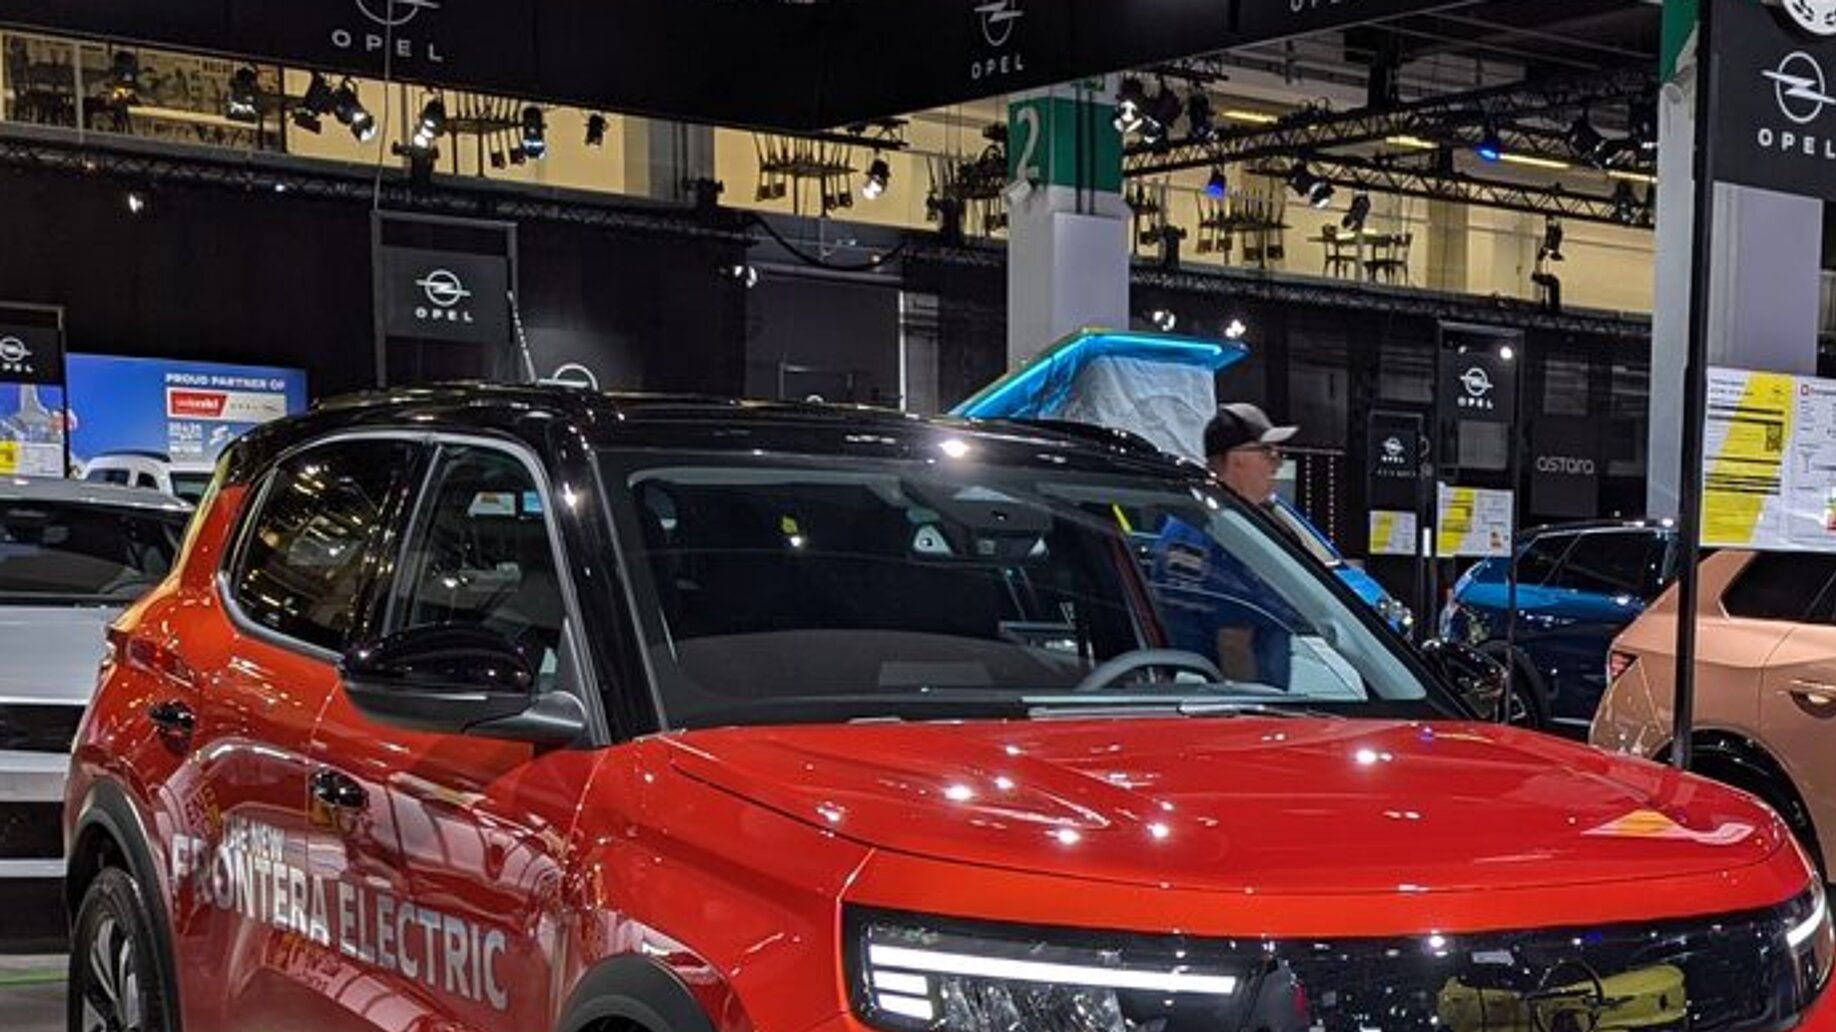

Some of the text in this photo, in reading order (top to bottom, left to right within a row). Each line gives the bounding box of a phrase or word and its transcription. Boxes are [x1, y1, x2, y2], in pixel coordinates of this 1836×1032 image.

[331, 28, 444, 62] OPEL
[971, 53, 1024, 79] OPEL
[1016, 106, 1039, 182] 2
[1757, 128, 1836, 160] OPEL
[415, 306, 474, 323] OPEL
[165, 373, 286, 390] PROUD PARTNER OF
[1457, 396, 1494, 409] OPEL
[172, 832, 509, 1012] FRONTERA ELECTRIC
